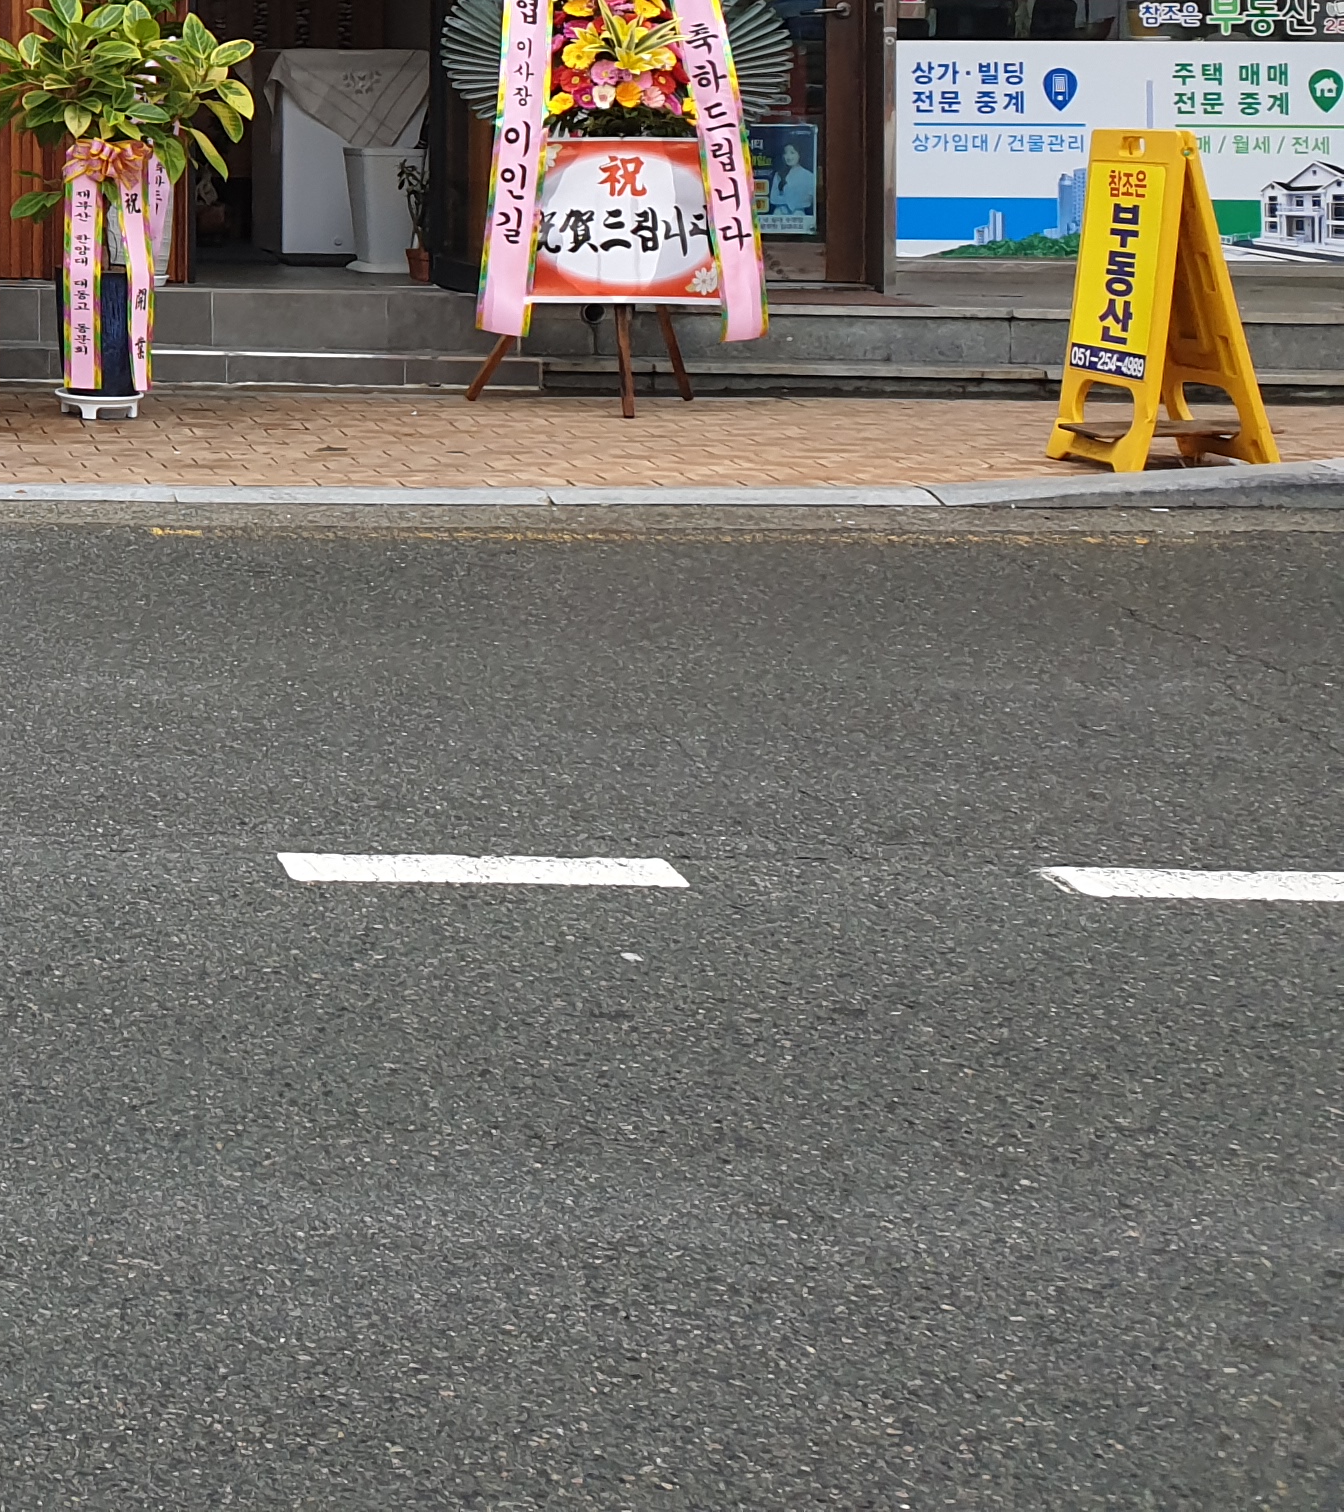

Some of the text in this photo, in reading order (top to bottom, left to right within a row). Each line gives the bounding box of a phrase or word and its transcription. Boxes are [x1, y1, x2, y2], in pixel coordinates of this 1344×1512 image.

[1138, 0, 1203, 28] 참조은
[512, 38, 534, 107] 이사장
[1172, 61, 1290, 87] 주택 매매
[912, 89, 1026, 115] 전문 중계
[1173, 90, 1290, 116] 전문 중계
[686, 21, 753, 253] 축하드립니다
[912, 132, 1085, 154] 상가임대 건물관리
[1232, 134, 1272, 155] 월세
[1291, 134, 1331, 156] 전세
[495, 119, 533, 246] 이인길
[597, 154, 648, 198] 祝
[1108, 168, 1148, 199] 참조은
[1098, 202, 1141, 347] 부동산
[1070, 345, 1145, 379] 051-254-4989
